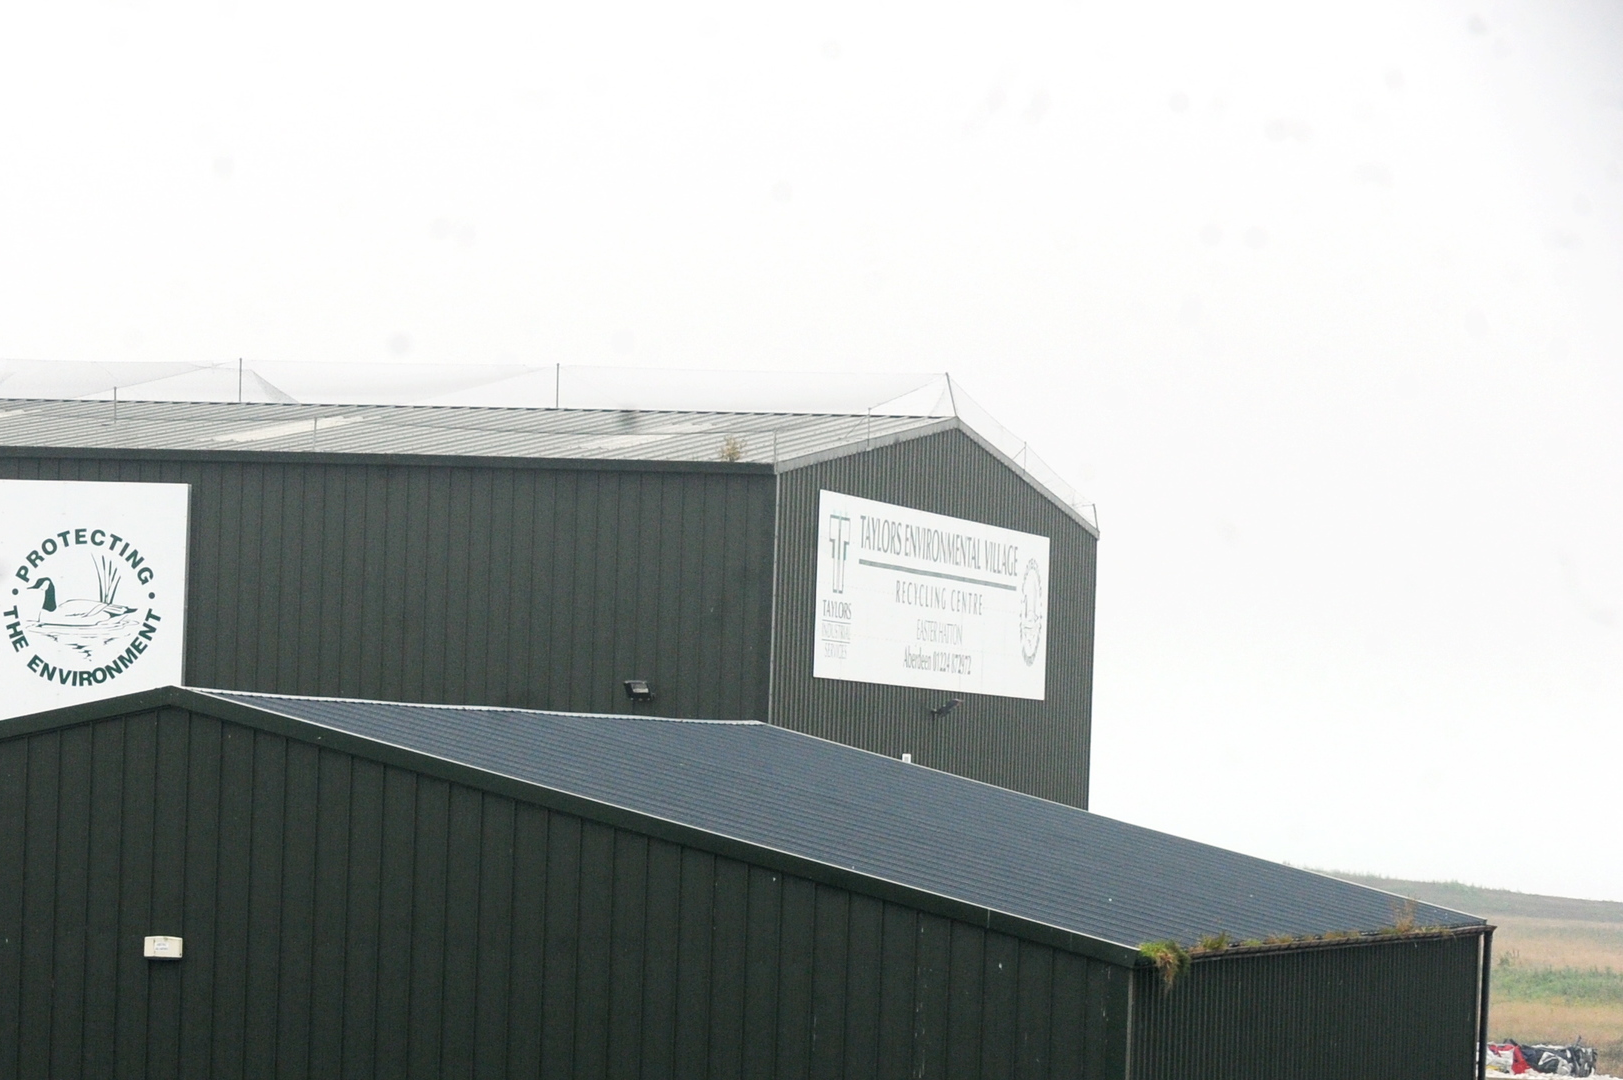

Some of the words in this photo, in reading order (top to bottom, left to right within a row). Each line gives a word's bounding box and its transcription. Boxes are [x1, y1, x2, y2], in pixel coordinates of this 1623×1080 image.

[15, 528, 154, 586] PROTECTING
[860, 515, 902, 556] TAYLORS
[904, 524, 981, 570] ENVIRONMENTAL
[985, 540, 1018, 577] VILLAGE
[822, 599, 852, 620] TAYLORS
[895, 580, 946, 610] RECYCLING
[951, 589, 983, 616] CENTRE
[3, 605, 29, 653] THE
[27, 608, 162, 687] ENVIRONMENT
[903, 645, 932, 671] Aberdeen
